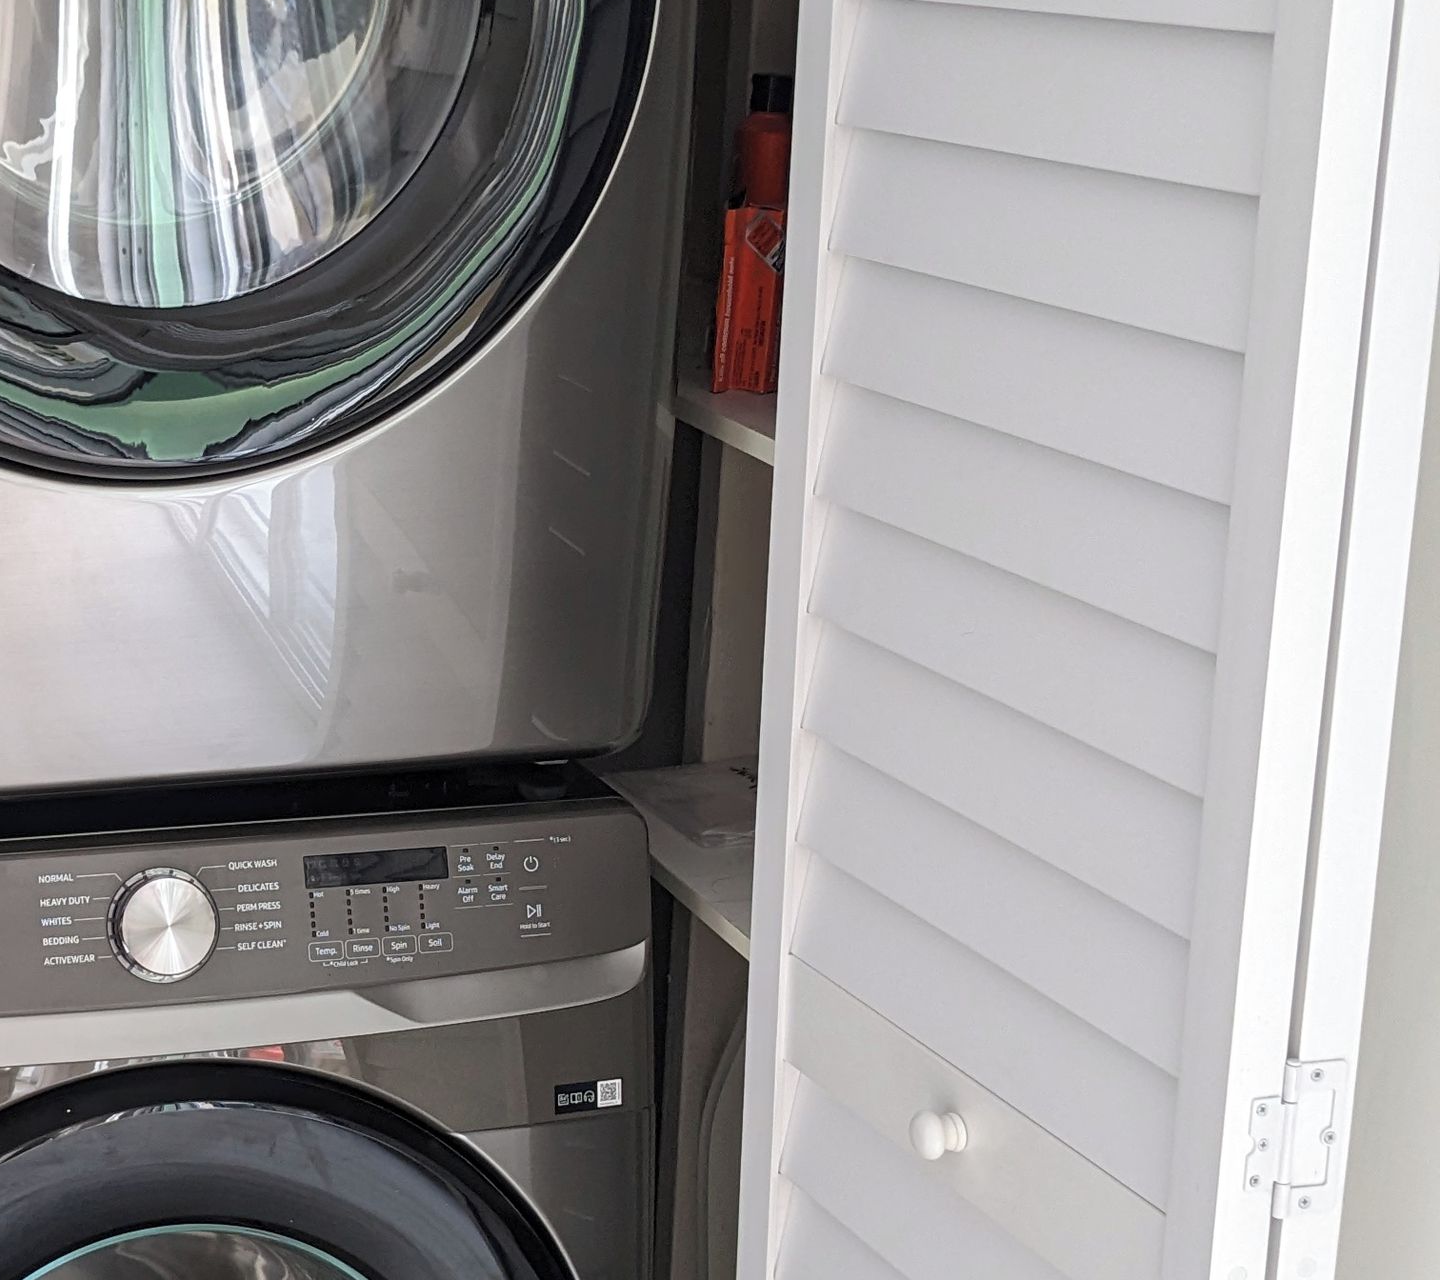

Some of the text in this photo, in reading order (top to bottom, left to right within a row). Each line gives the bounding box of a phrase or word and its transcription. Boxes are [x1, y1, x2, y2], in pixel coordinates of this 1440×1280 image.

[459, 855, 471, 863] Pre
[486, 853, 505, 862] Delay
[228, 859, 277, 871] QUICK WASH
[457, 864, 474, 872] Soak
[38, 873, 74, 883] NORMAL
[237, 881, 280, 893] DELICATES
[457, 886, 478, 894] Alarm
[488, 884, 508, 892] Smart
[462, 895, 474, 903] Off
[490, 892, 506, 900] Care
[40, 896, 90, 907] HEAVY DUTY
[236, 901, 281, 912] PERM PRESS
[40, 916, 72, 927] WHITES
[42, 935, 79, 946] BEDDING
[428, 938, 442, 947] Soil
[237, 942, 256, 951] SELF
[353, 944, 373, 952] Rinse
[391, 941, 408, 951] Spin
[315, 947, 338, 956] Temp.
[43, 954, 95, 965] ACTIVEWEAR
